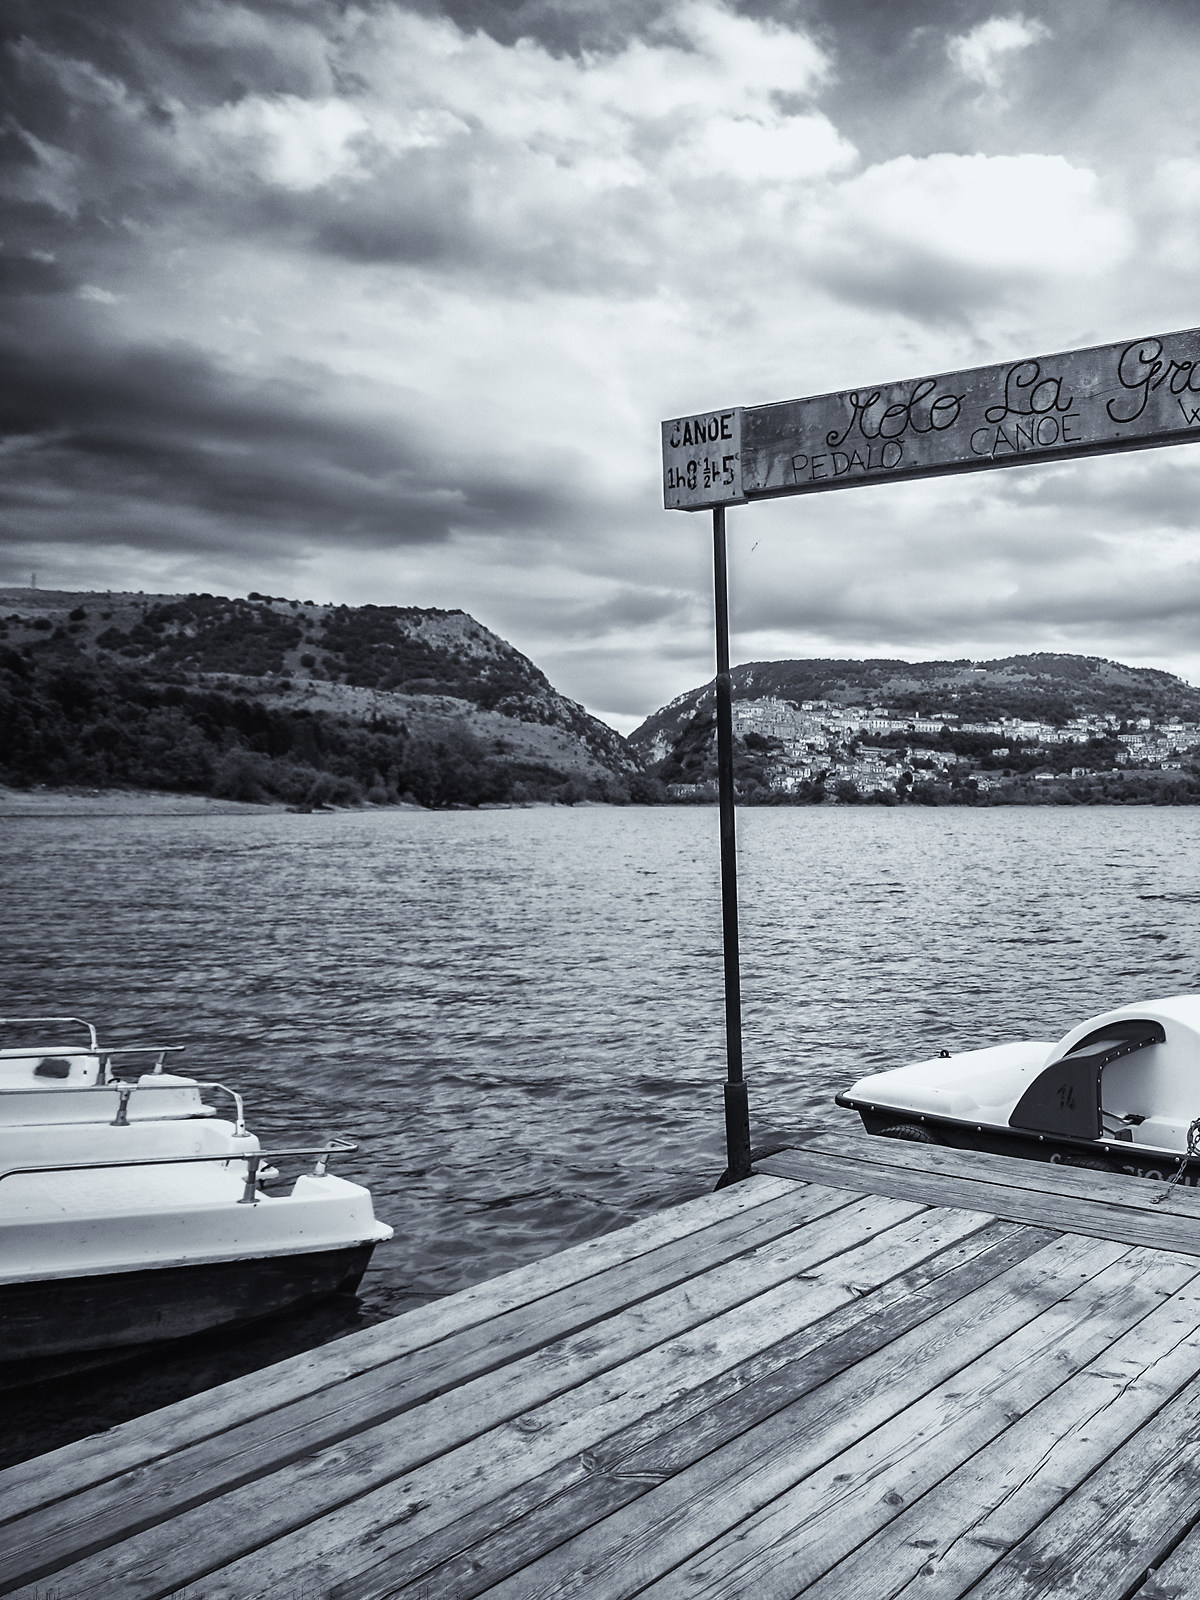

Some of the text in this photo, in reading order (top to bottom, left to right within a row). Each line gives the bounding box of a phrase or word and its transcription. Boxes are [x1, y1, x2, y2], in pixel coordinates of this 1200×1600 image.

[985, 360, 1073, 424] La
[669, 413, 733, 448] CANOE
[970, 413, 1082, 456] CANOE
